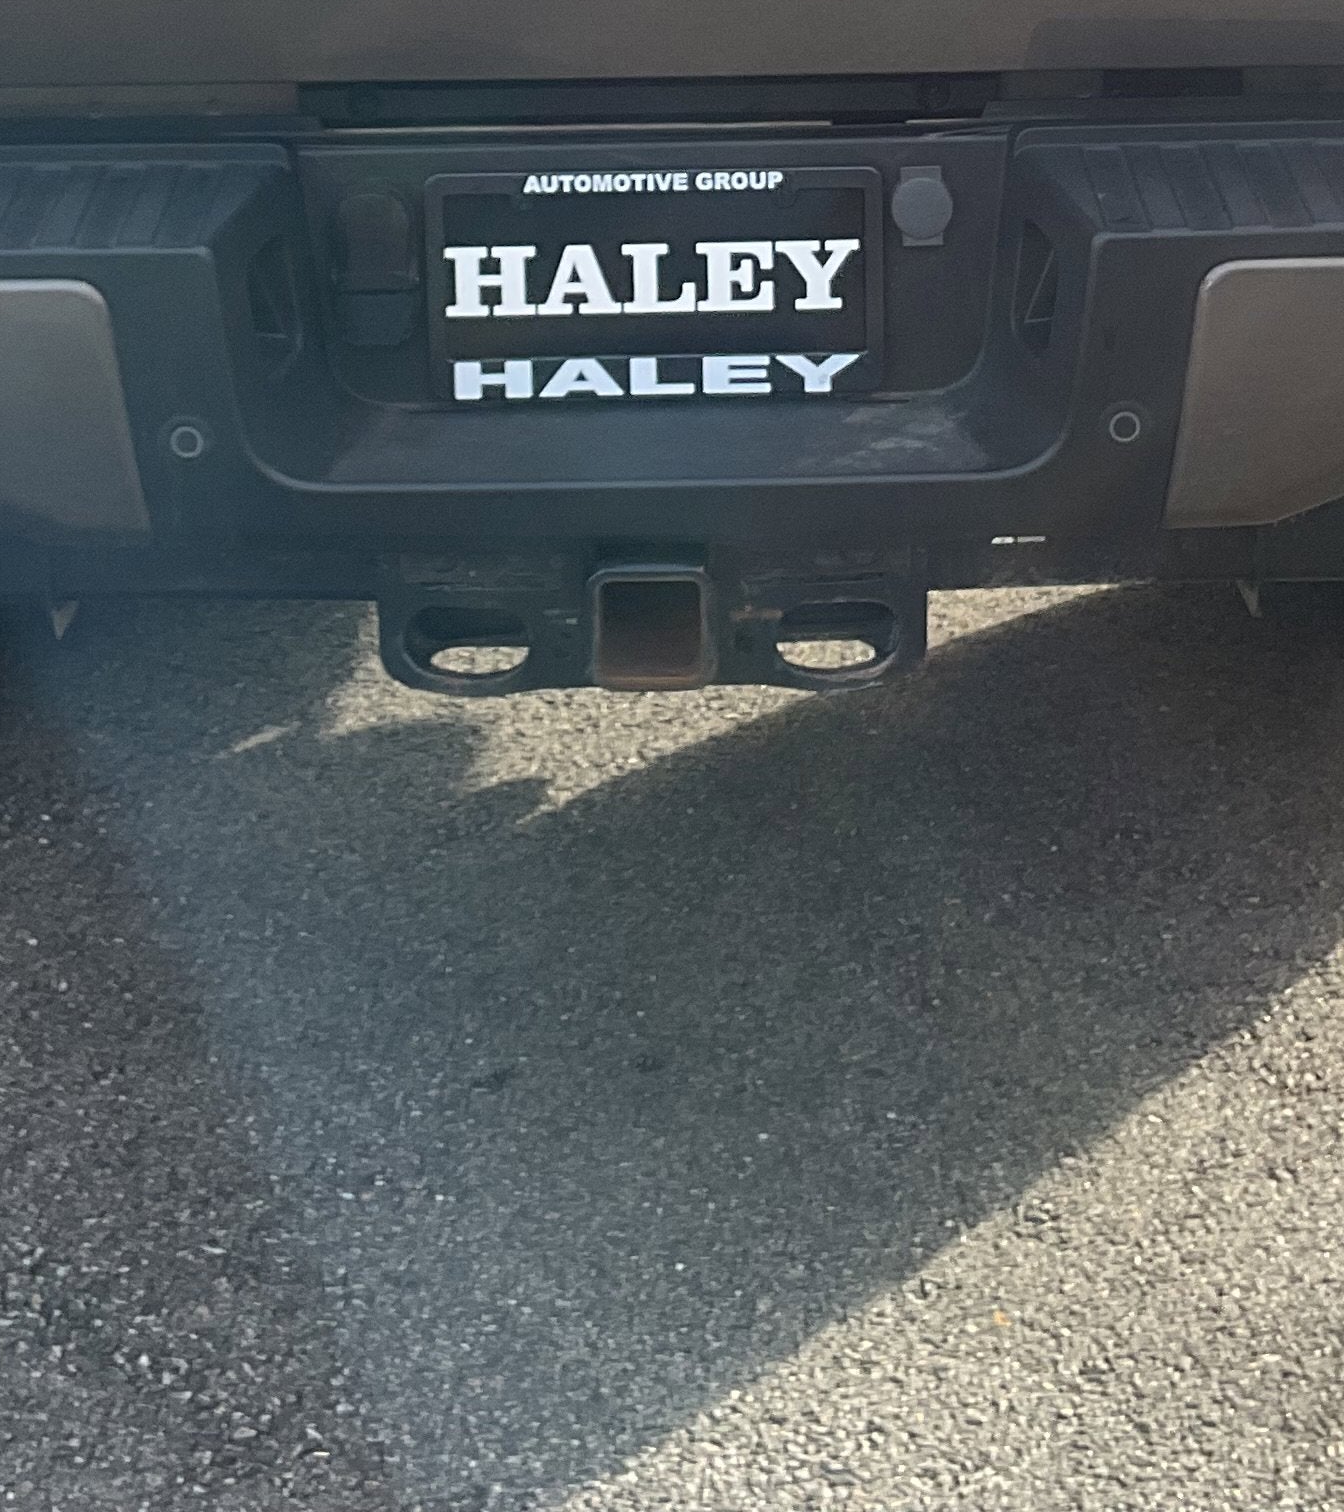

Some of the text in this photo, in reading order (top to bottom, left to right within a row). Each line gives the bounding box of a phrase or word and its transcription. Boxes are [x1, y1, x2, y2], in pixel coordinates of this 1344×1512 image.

[522, 171, 784, 193] AUTOMOTIVE GROUP
[444, 239, 860, 317] HALEY
[453, 354, 860, 400] HALEY
